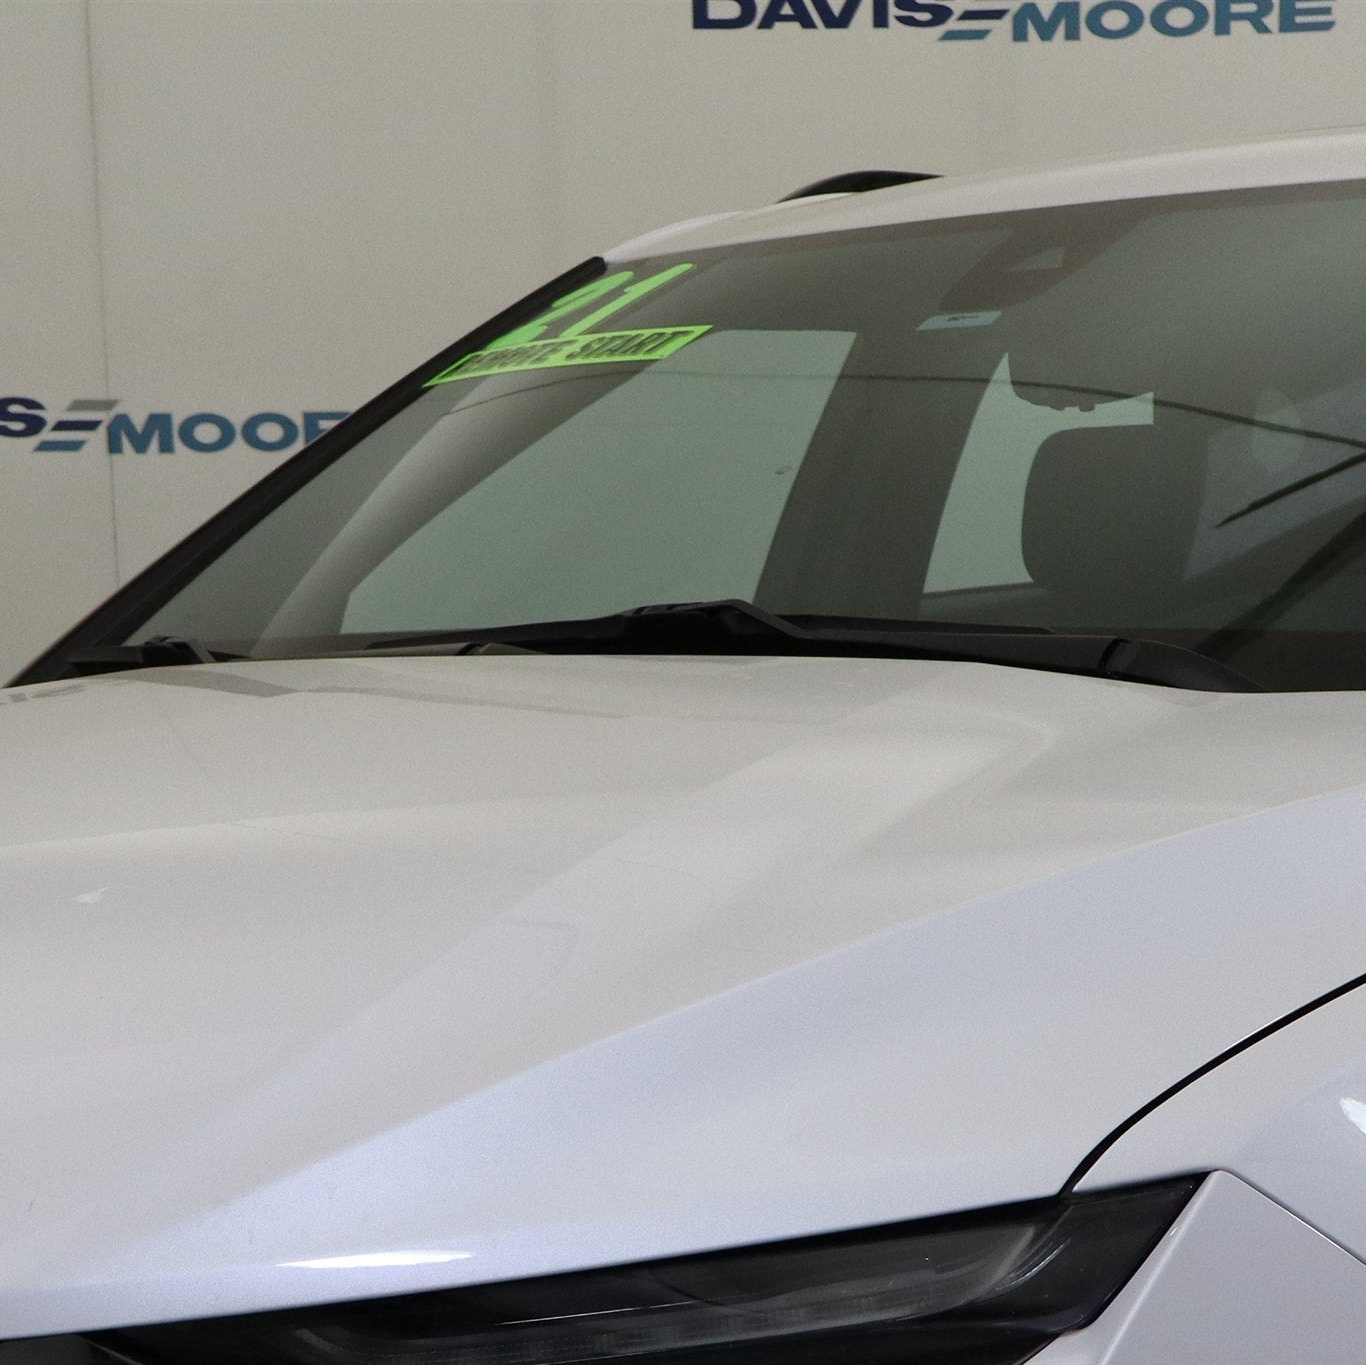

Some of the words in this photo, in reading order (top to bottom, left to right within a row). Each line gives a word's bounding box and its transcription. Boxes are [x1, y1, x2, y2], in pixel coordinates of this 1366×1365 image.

[692, 0, 954, 30] DAVIS
[1011, 0, 1336, 42] MOORE
[564, 330, 695, 362] START
